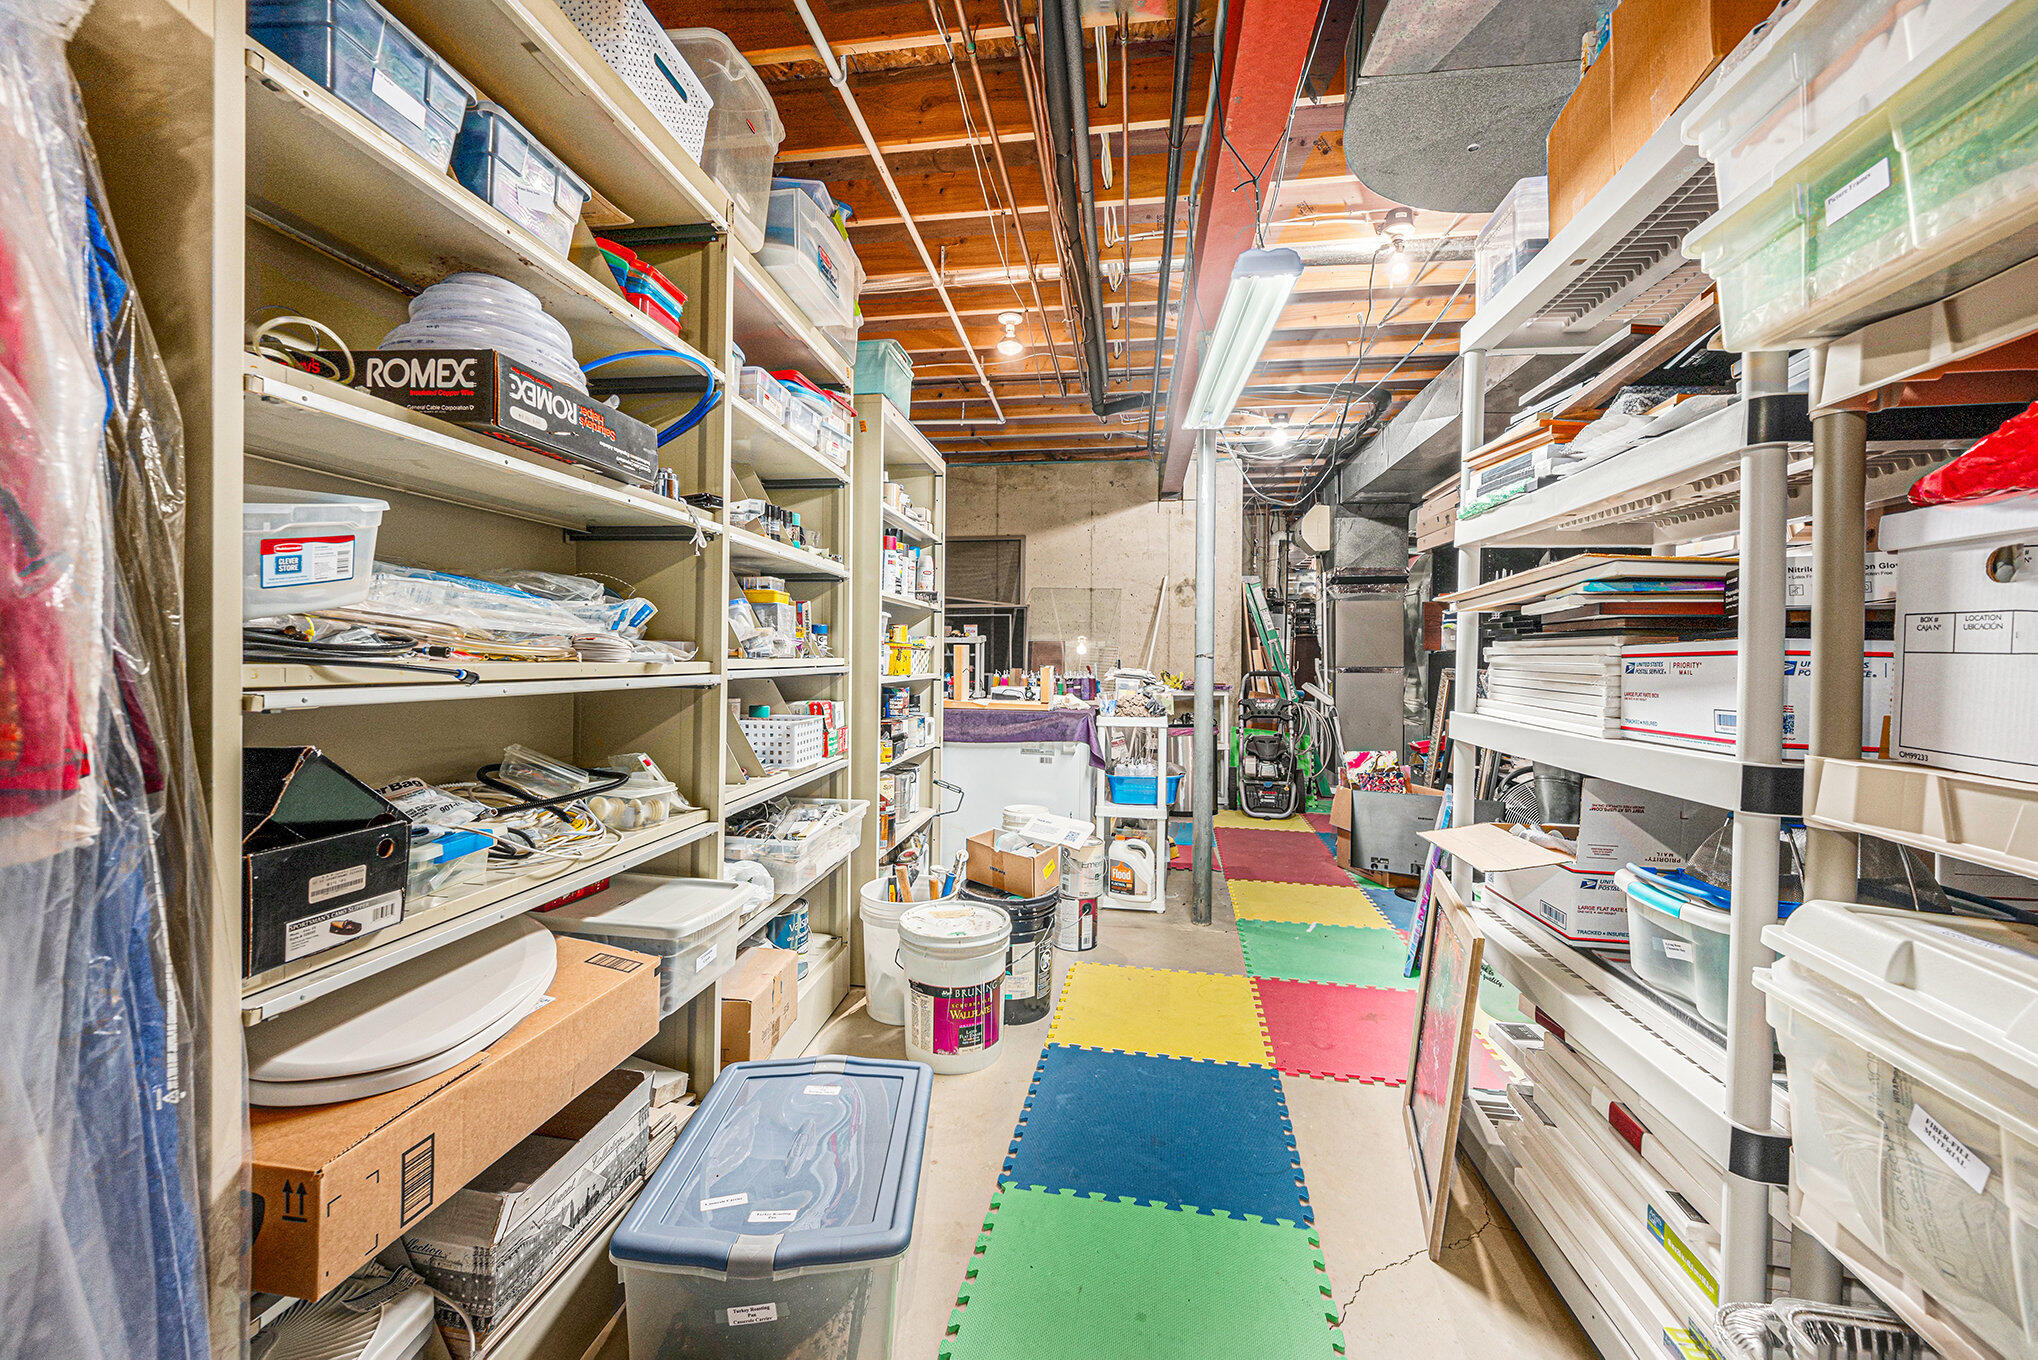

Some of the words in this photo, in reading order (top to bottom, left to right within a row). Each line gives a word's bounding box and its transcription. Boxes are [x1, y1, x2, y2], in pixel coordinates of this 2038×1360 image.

[366, 357, 477, 388] ROMEX
[438, 389, 460, 397] Copper
[508, 373, 578, 425] ROMEX
[278, 557, 299, 565] CLEVER
[278, 564, 299, 572] STORE
[1965, 614, 2002, 622] LOCATION
[1112, 867, 1132, 880] Flood
[1924, 1117, 1971, 1162] FIBER-FILL
[1923, 1126, 1967, 1169] MATERIAL
